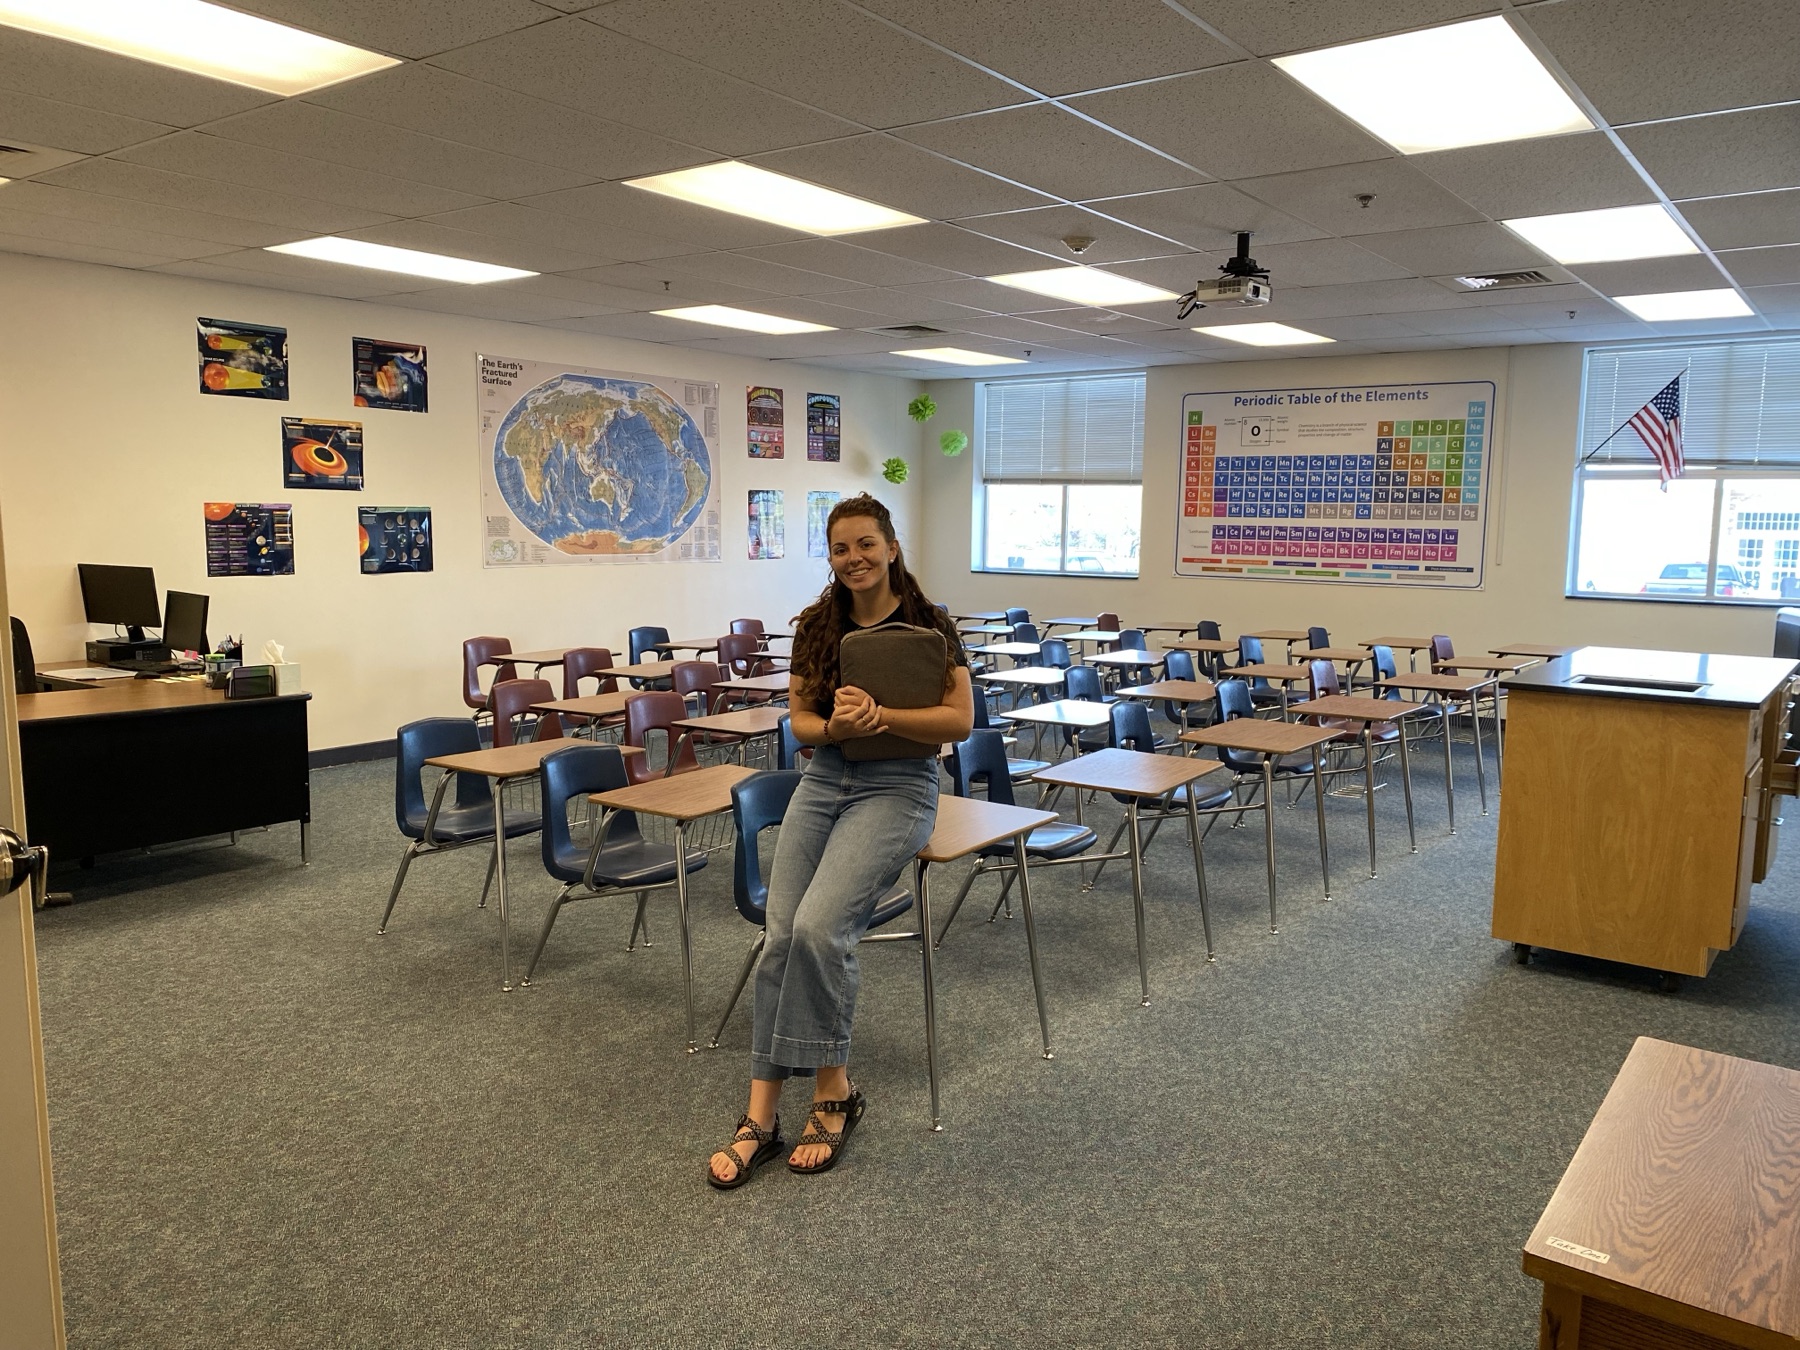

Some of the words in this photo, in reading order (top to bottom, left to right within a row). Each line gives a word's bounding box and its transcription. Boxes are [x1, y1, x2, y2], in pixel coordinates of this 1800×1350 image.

[482, 359, 495, 367] The
[497, 361, 523, 370] Earth's
[482, 367, 517, 378] Fractured
[482, 376, 512, 386] Surface
[1234, 395, 1283, 406] Periodic
[1287, 394, 1321, 405] Table
[1325, 392, 1337, 403] of
[1341, 392, 1362, 402] the
[1366, 389, 1429, 402] Elements
[1470, 406, 1483, 414] He
[1251, 425, 1260, 436] O
[1203, 445, 1213, 454] Mg
[1451, 440, 1460, 448] Cl
[1396, 458, 1406, 466] Ge
[1344, 475, 1354, 484] Ag
[1360, 492, 1370, 500] Hg
[1394, 491, 1404, 499] Pb
[1262, 507, 1271, 515] Sg
[1342, 508, 1352, 517] Rg
[1464, 509, 1475, 518] Og
[1274, 529, 1287, 537] Pm
[1308, 530, 1317, 538] Eu
[1357, 531, 1367, 540] Dy
[1408, 532, 1420, 540] Tm
[1274, 545, 1285, 554] Np
[1322, 546, 1334, 554] Cm
[1357, 547, 1366, 555] Cf
[1390, 548, 1402, 556] Fm
[1551, 1237, 1577, 1250] Take
